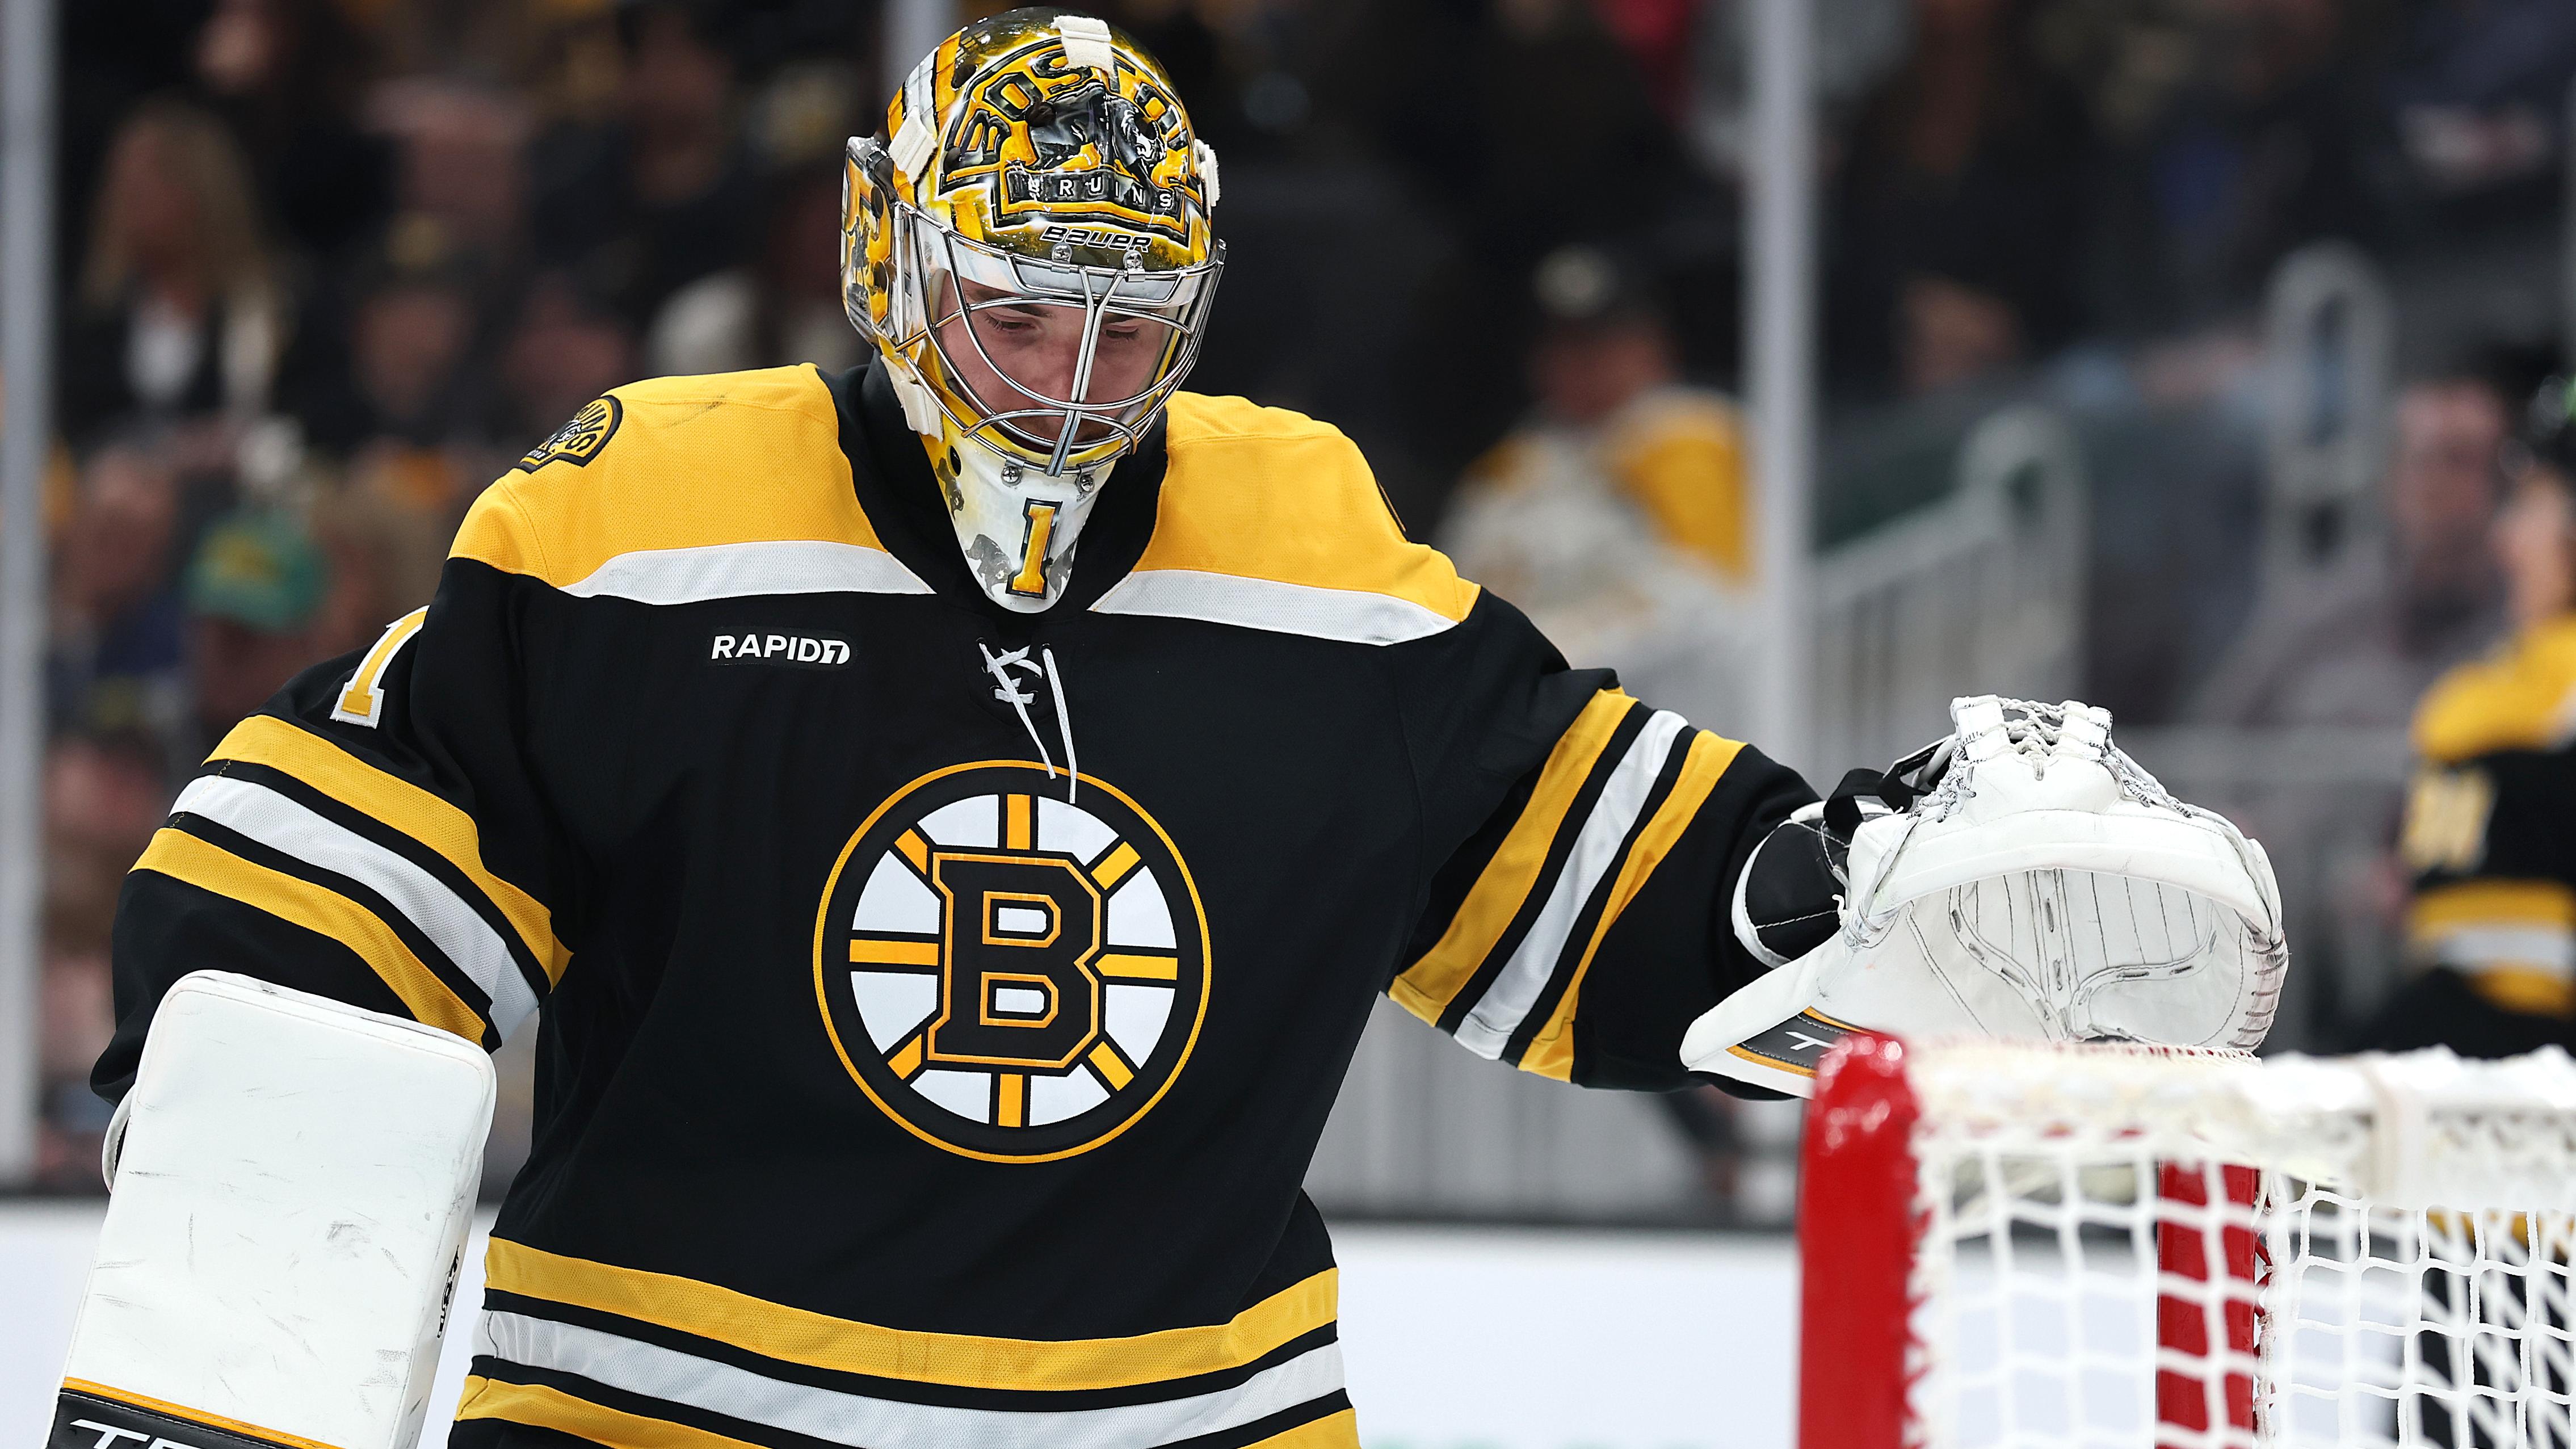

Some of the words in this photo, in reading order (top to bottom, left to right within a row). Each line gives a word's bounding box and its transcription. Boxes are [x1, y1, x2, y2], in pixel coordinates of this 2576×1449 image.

[1028, 175, 1173, 208] BRUINS
[1006, 497, 1063, 599] 1
[329, 604, 430, 730] 1
[711, 633, 850, 665] RAPID7
[927, 851, 1102, 1069] B
